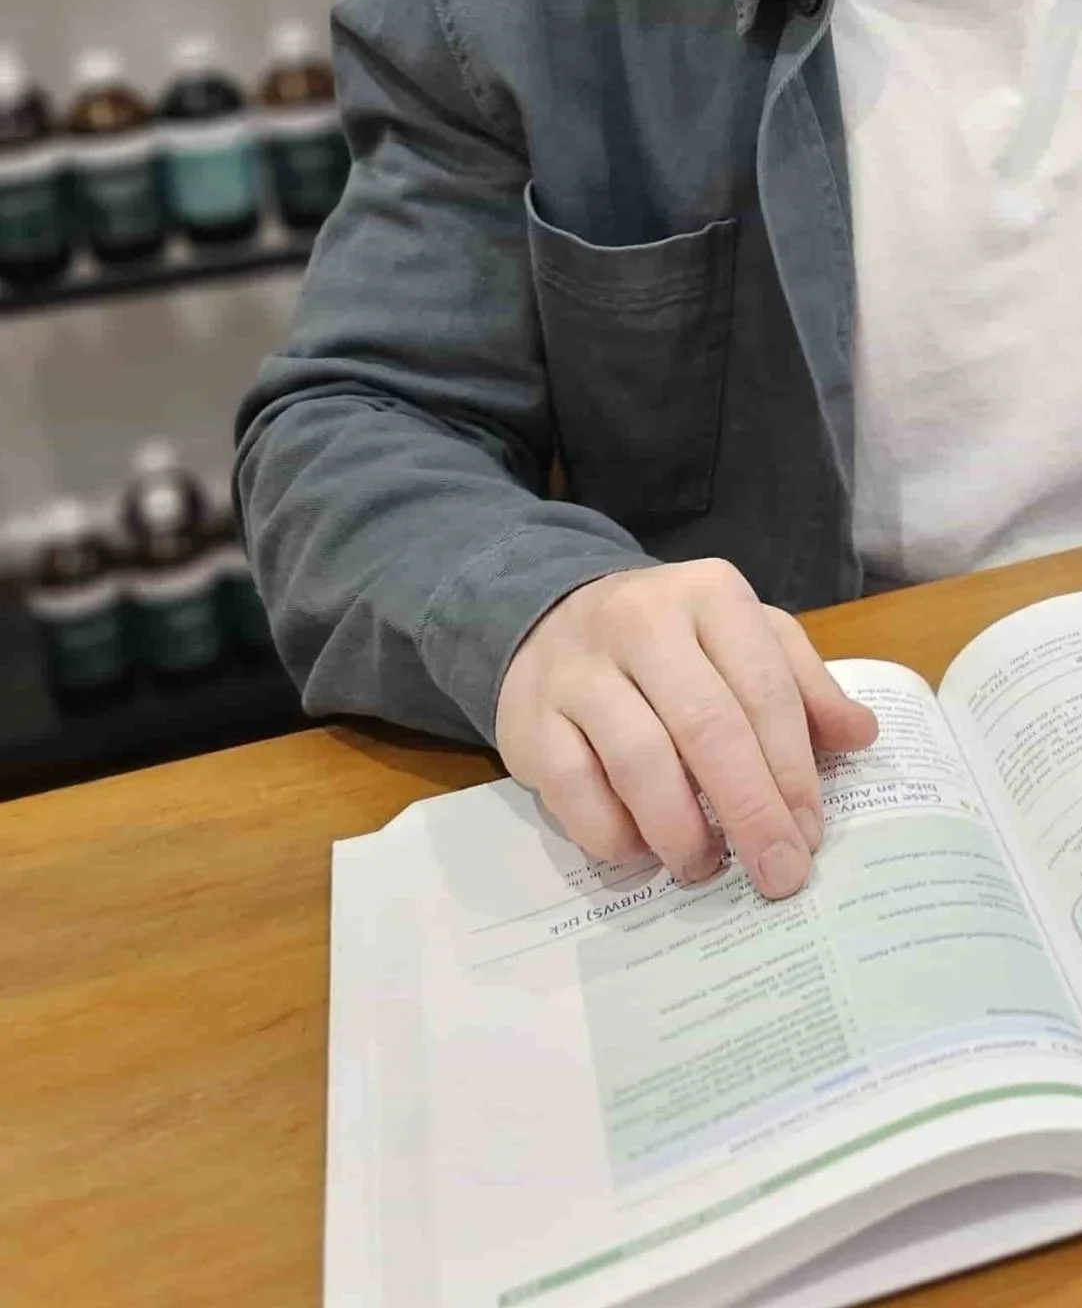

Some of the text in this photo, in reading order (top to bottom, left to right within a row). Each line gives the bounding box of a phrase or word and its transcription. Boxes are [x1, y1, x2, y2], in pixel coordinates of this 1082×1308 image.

[876, 784, 897, 794] an
[900, 781, 938, 794] bite,
[902, 792, 942, 805] Case
[585, 882, 653, 922] (NBWS)
[548, 914, 582, 939] tick
